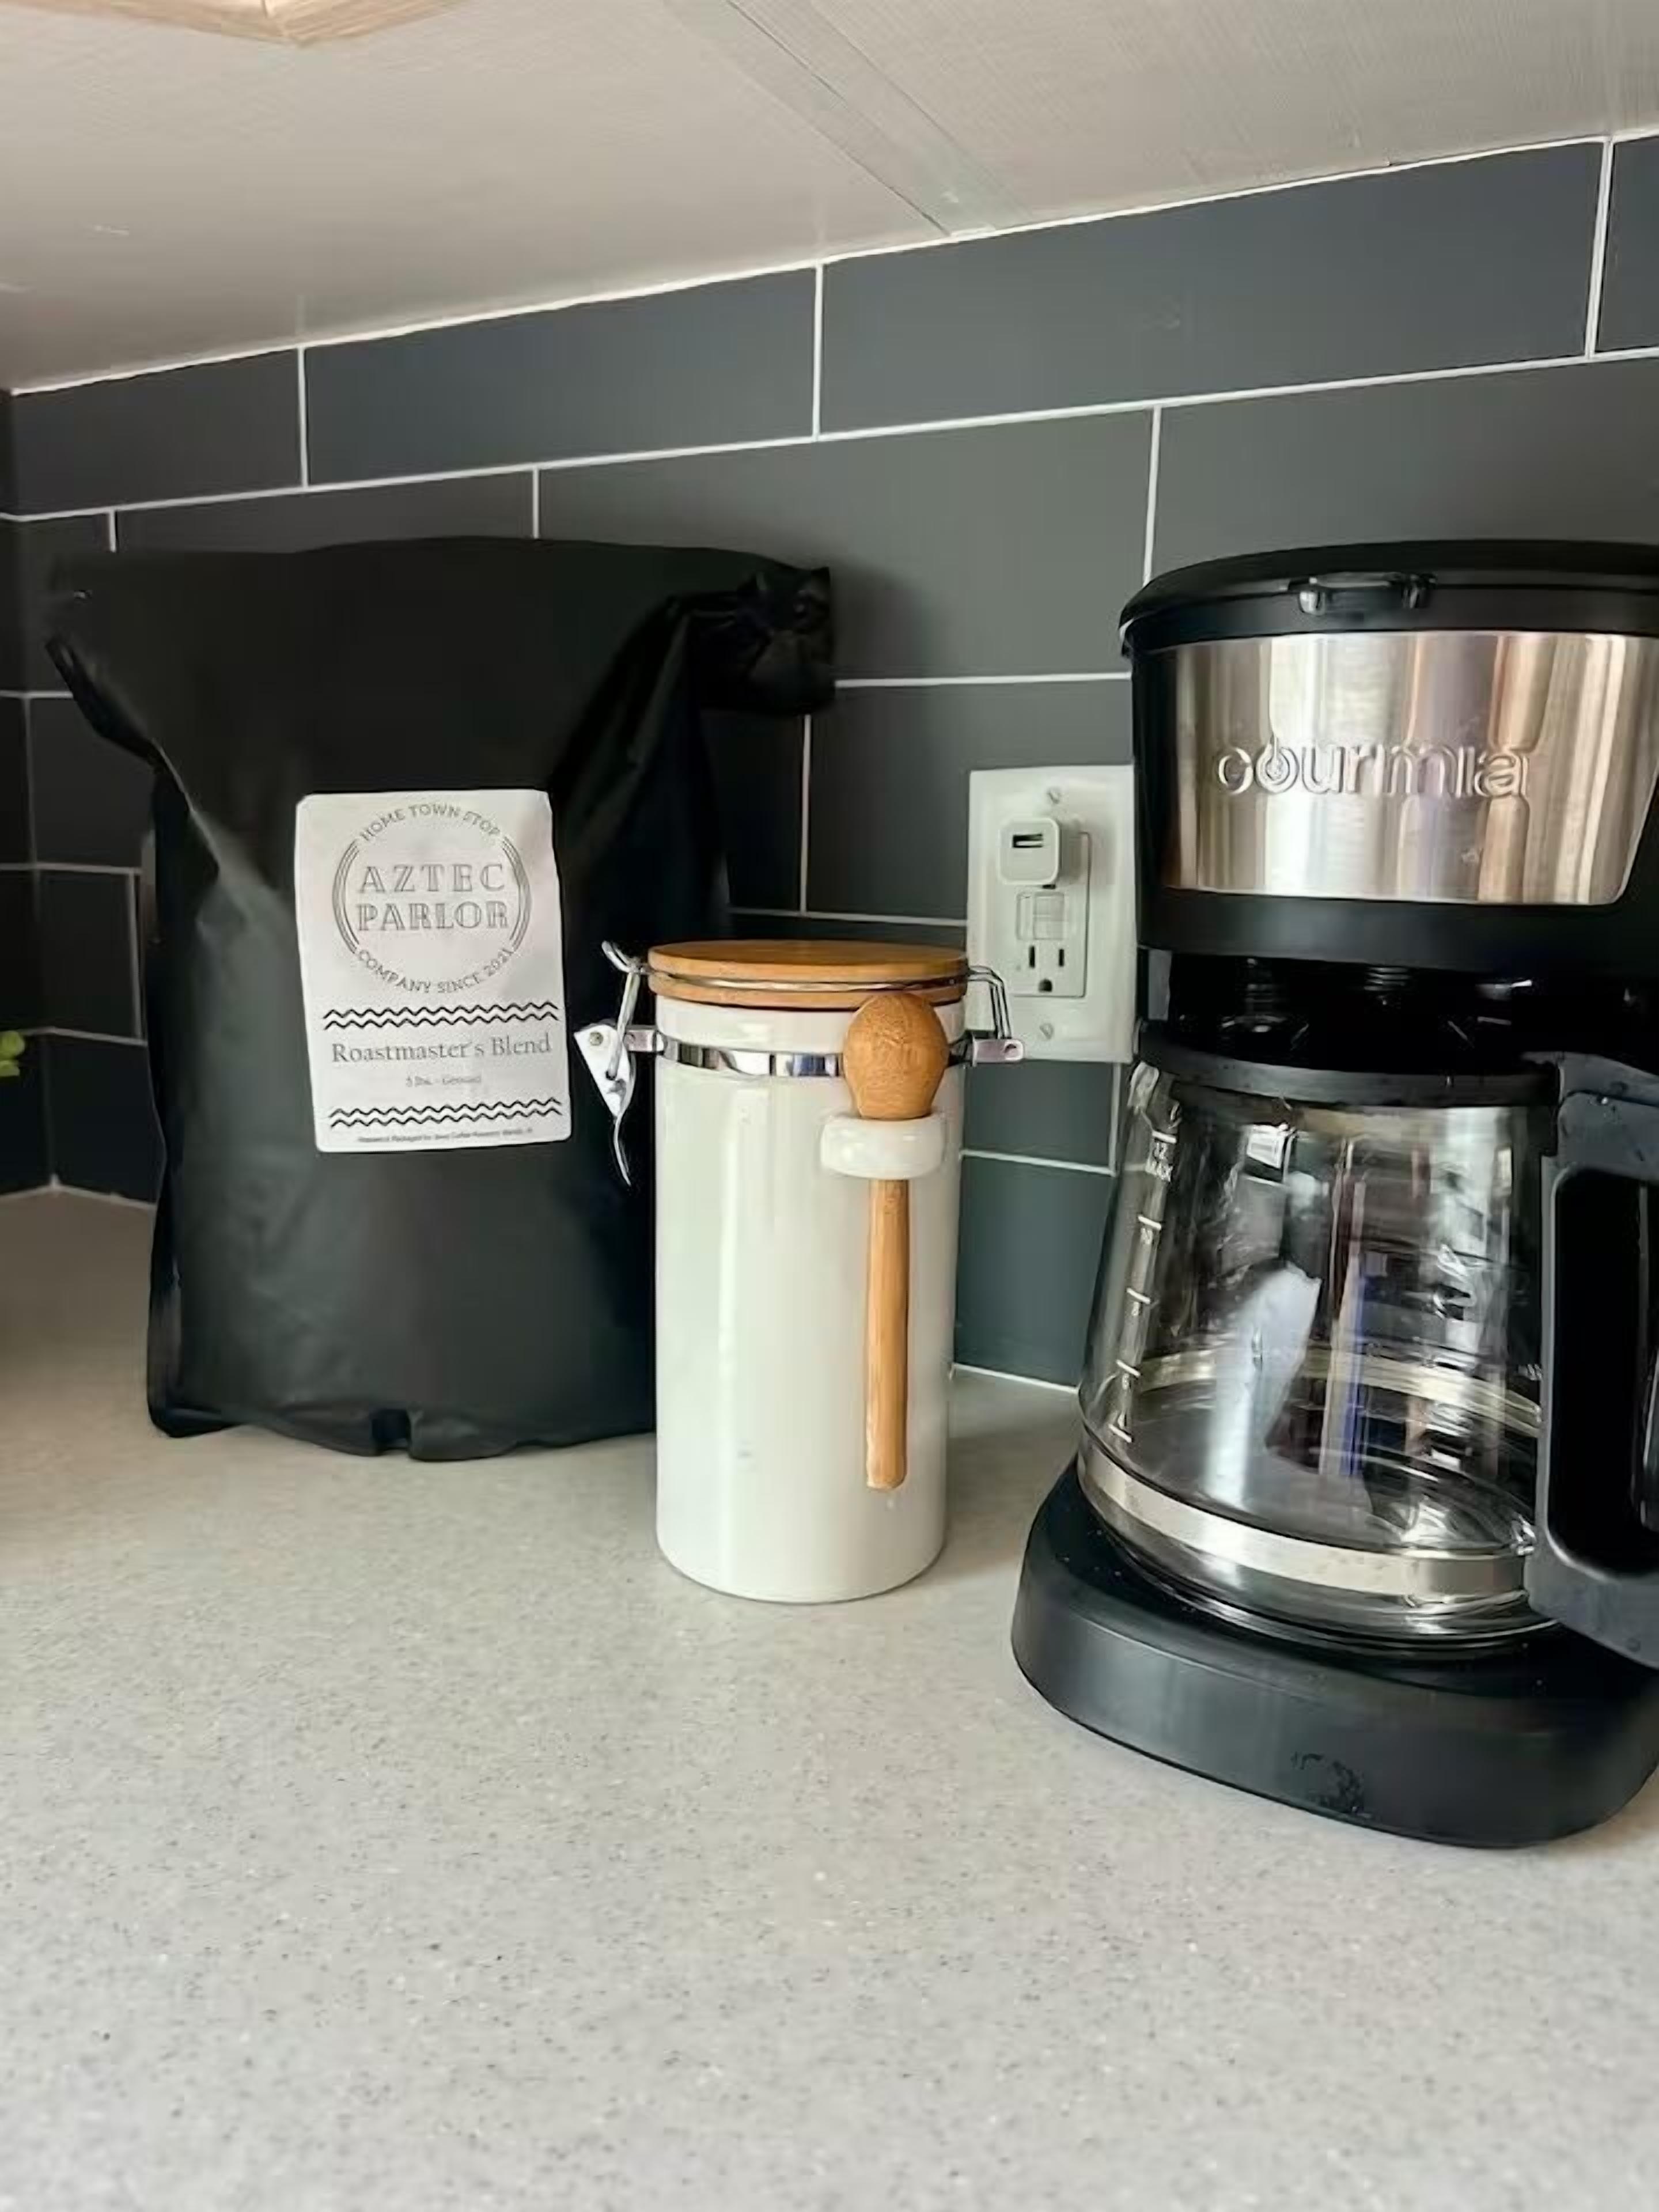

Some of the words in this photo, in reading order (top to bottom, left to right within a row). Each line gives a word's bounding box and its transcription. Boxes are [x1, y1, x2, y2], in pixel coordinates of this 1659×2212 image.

[359, 809, 405, 841] HOME
[408, 804, 460, 818] TOWN
[463, 810, 501, 835] STOP
[359, 863, 505, 893] AZTEC
[357, 900, 508, 931] PARLOR
[358, 949, 431, 993] COMPANY
[437, 972, 482, 993] SINCE
[332, 1041, 484, 1063] Roastmaster's
[492, 1032, 551, 1055] Blend
